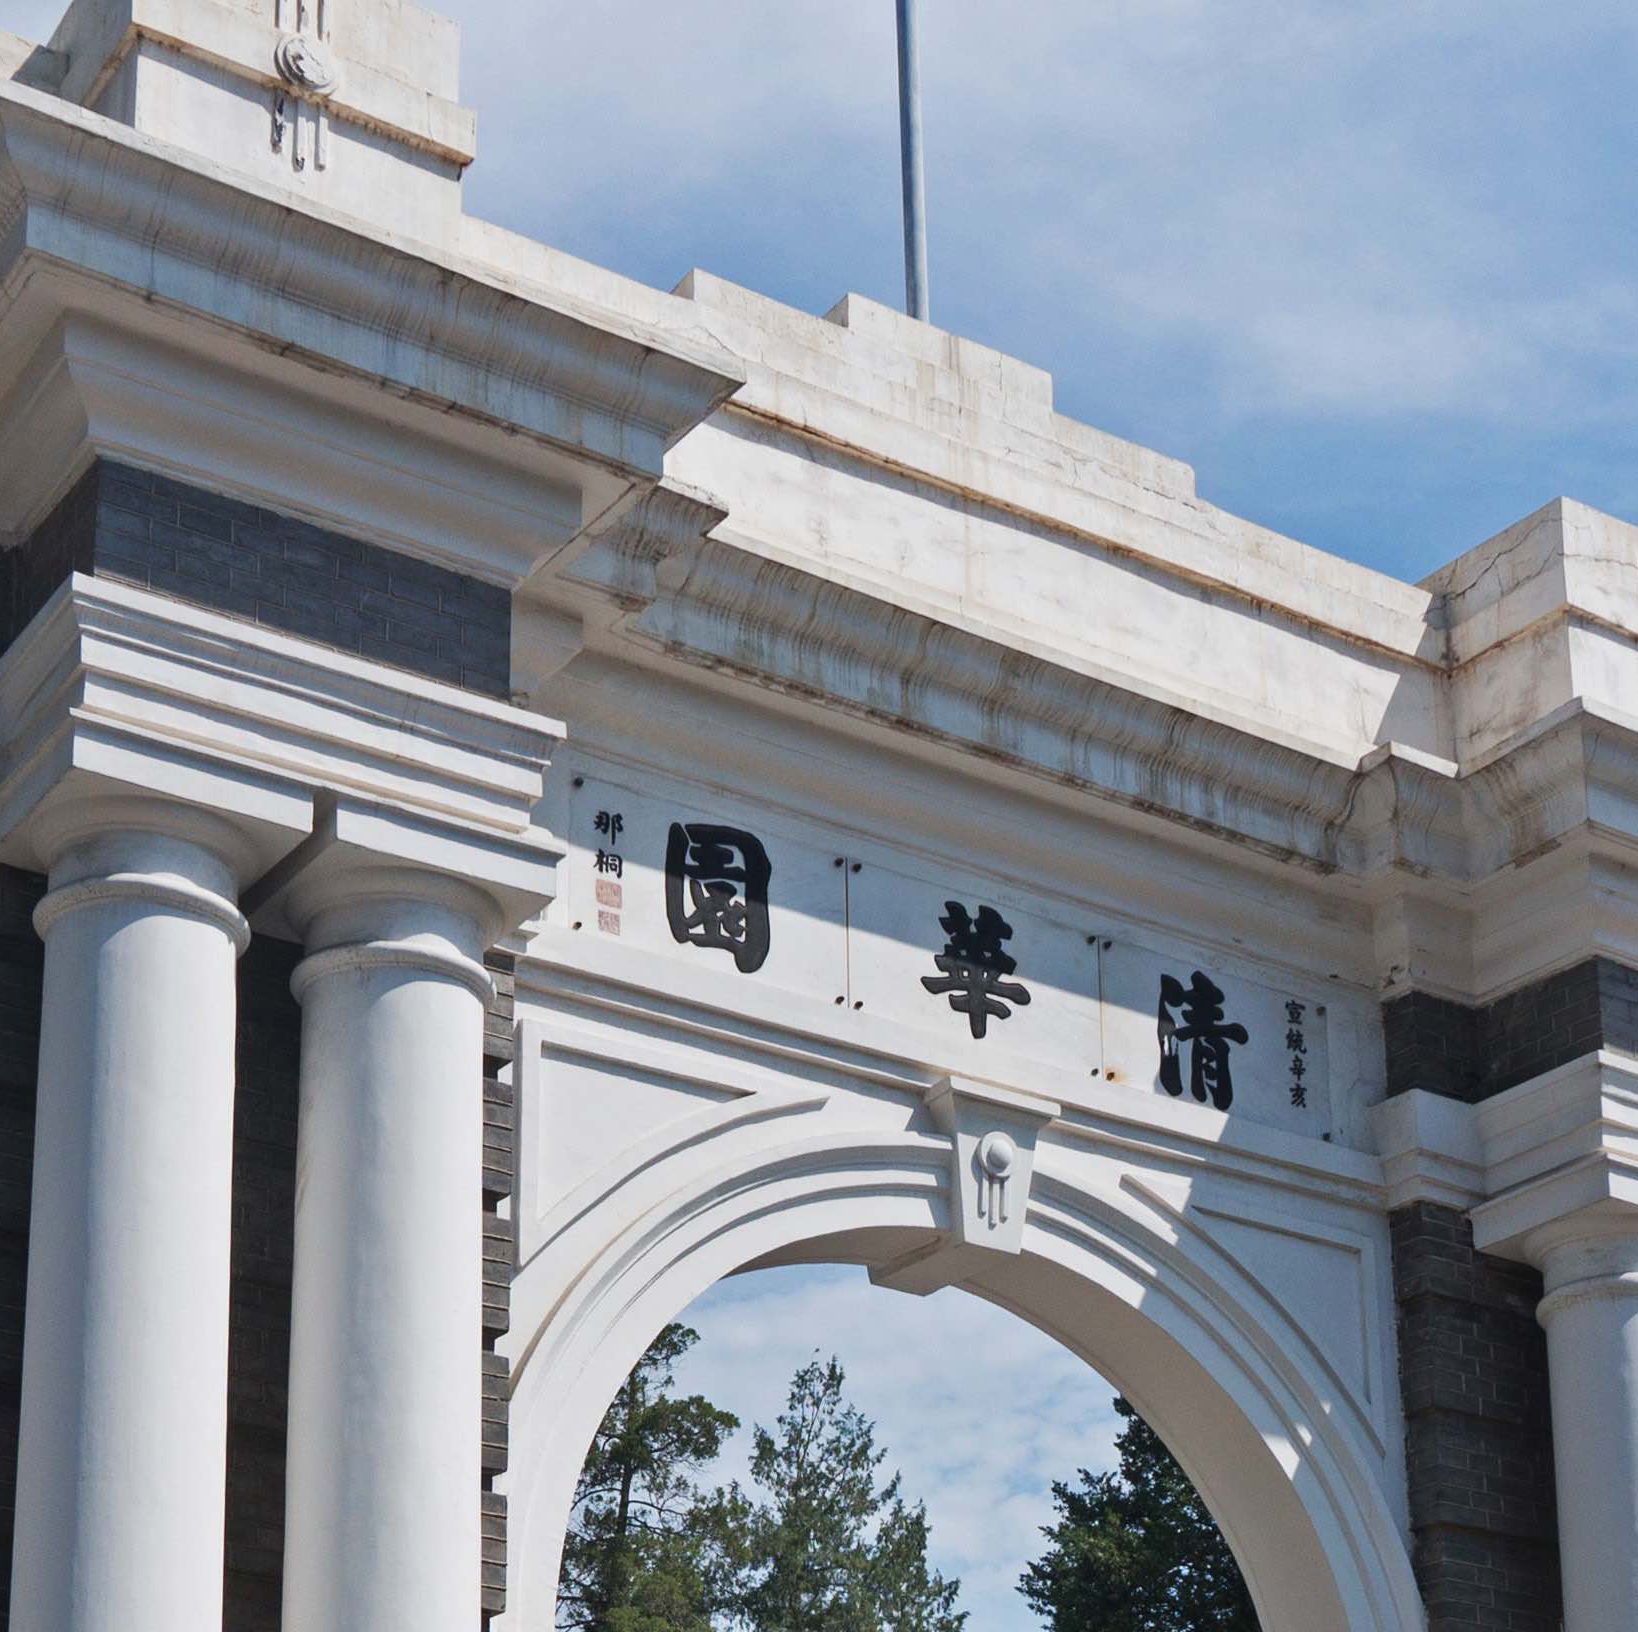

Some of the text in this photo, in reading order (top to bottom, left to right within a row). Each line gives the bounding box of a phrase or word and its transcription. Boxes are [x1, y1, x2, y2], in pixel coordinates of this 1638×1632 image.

[593, 809, 624, 879] 那桐
[1285, 999, 1308, 1109] 宣統辛亥
